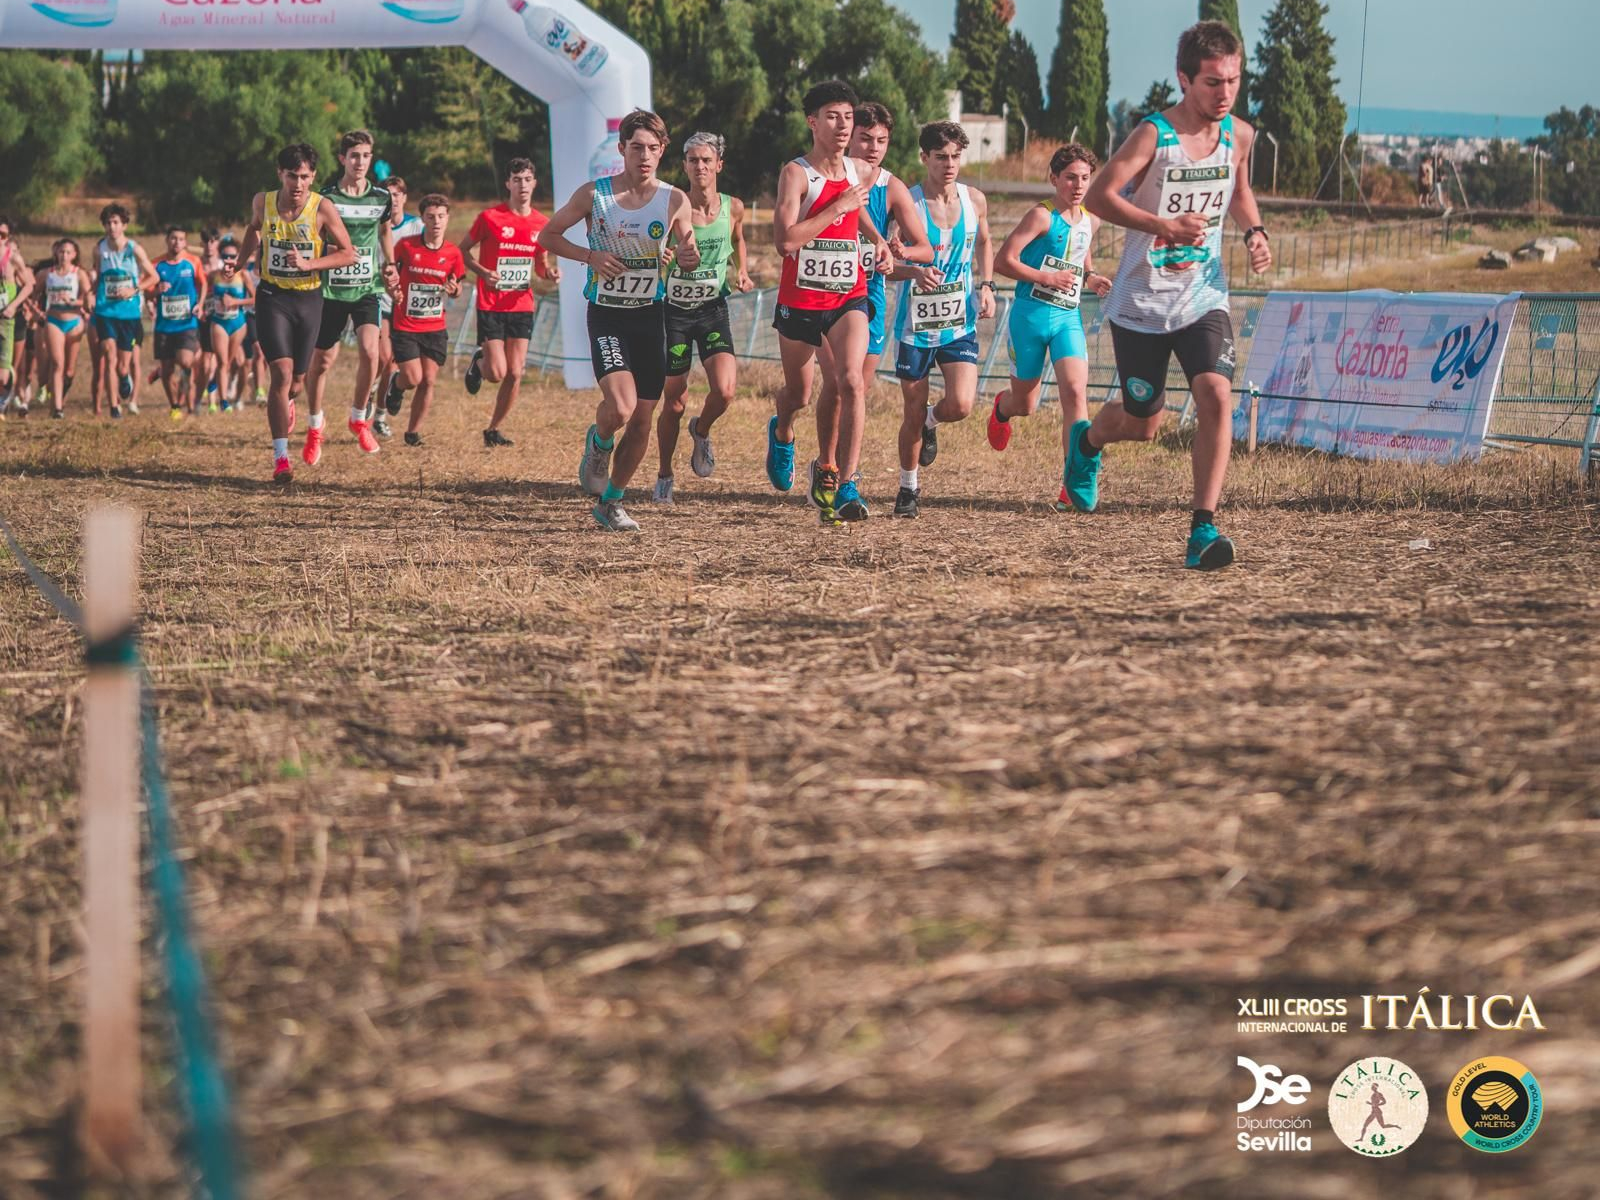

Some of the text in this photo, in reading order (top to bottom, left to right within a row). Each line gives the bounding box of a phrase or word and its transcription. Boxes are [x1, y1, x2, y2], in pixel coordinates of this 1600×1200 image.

[158, 9, 337, 27] Agua Mineral Natural
[1166, 190, 1224, 214] 8174
[499, 242, 515, 251] SAN
[333, 261, 370, 276] 8185
[500, 270, 529, 281] 8202
[803, 258, 854, 278] 8163
[602, 275, 655, 295] 8177
[671, 284, 716, 299] 8232
[410, 295, 442, 309] 8203
[916, 299, 963, 319] 8157
[1335, 327, 1409, 381] Cazorla
